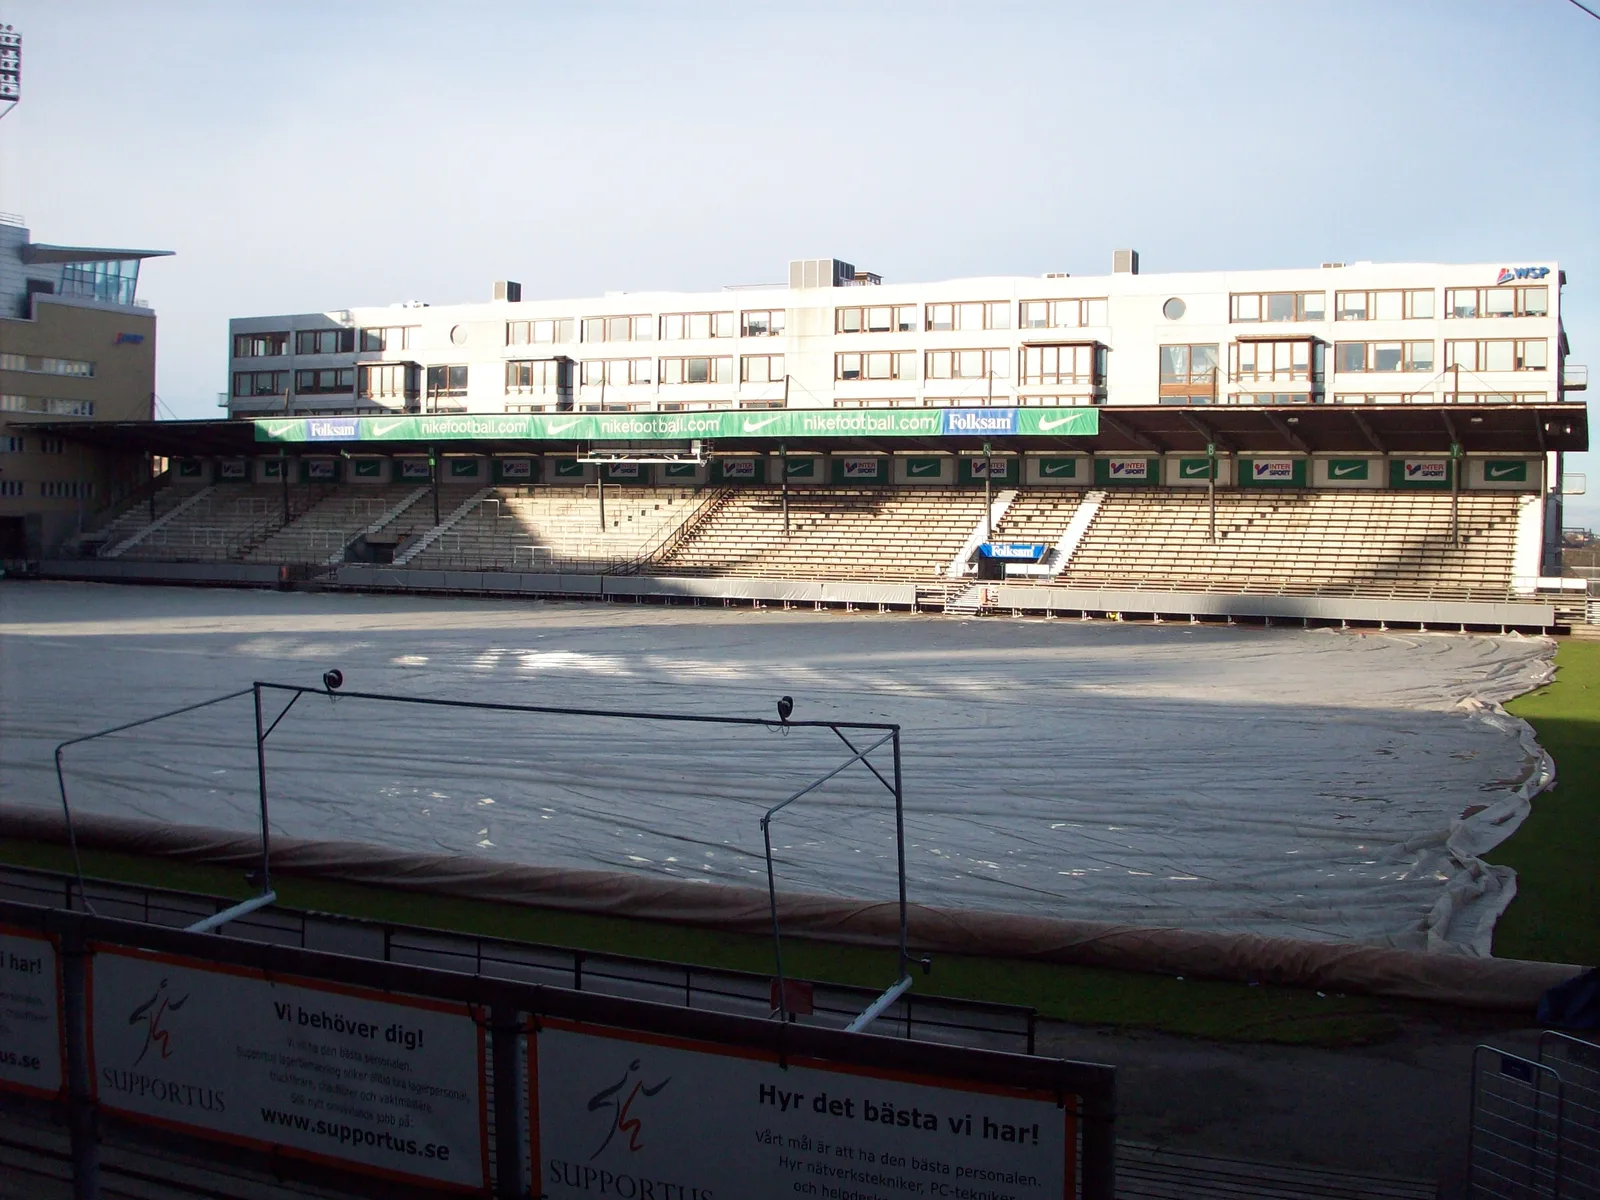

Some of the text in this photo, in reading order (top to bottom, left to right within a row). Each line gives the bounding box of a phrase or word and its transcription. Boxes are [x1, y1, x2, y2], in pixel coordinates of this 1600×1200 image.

[1513, 266, 1551, 280] WSP
[311, 421, 355, 436] Folksam
[421, 419, 527, 434] nikefootball.com
[601, 417, 720, 433] nikefootball.com
[803, 413, 936, 432] nikefootball.com
[948, 413, 1012, 430] Folksam
[1208, 443, 1214, 455] B
[991, 545, 1034, 558] Folksam
[9, 952, 42, 974] har!
[274, 1002, 424, 1051] Vi behöver dig!
[321, 1043, 337, 1057] den
[102, 1067, 226, 1113] SUPPORTUS
[360, 1090, 376, 1103] och
[759, 1083, 1040, 1146] Hyr det bästa vi har!
[260, 1107, 450, 1161] www.supportus.se
[755, 1128, 1042, 1188] Vårt mål är att ha den bästa personalen.
[779, 1155, 803, 1173] Hyr
[806, 1160, 925, 1195] nätverkstekniker,
[793, 1180, 817, 1196] och
